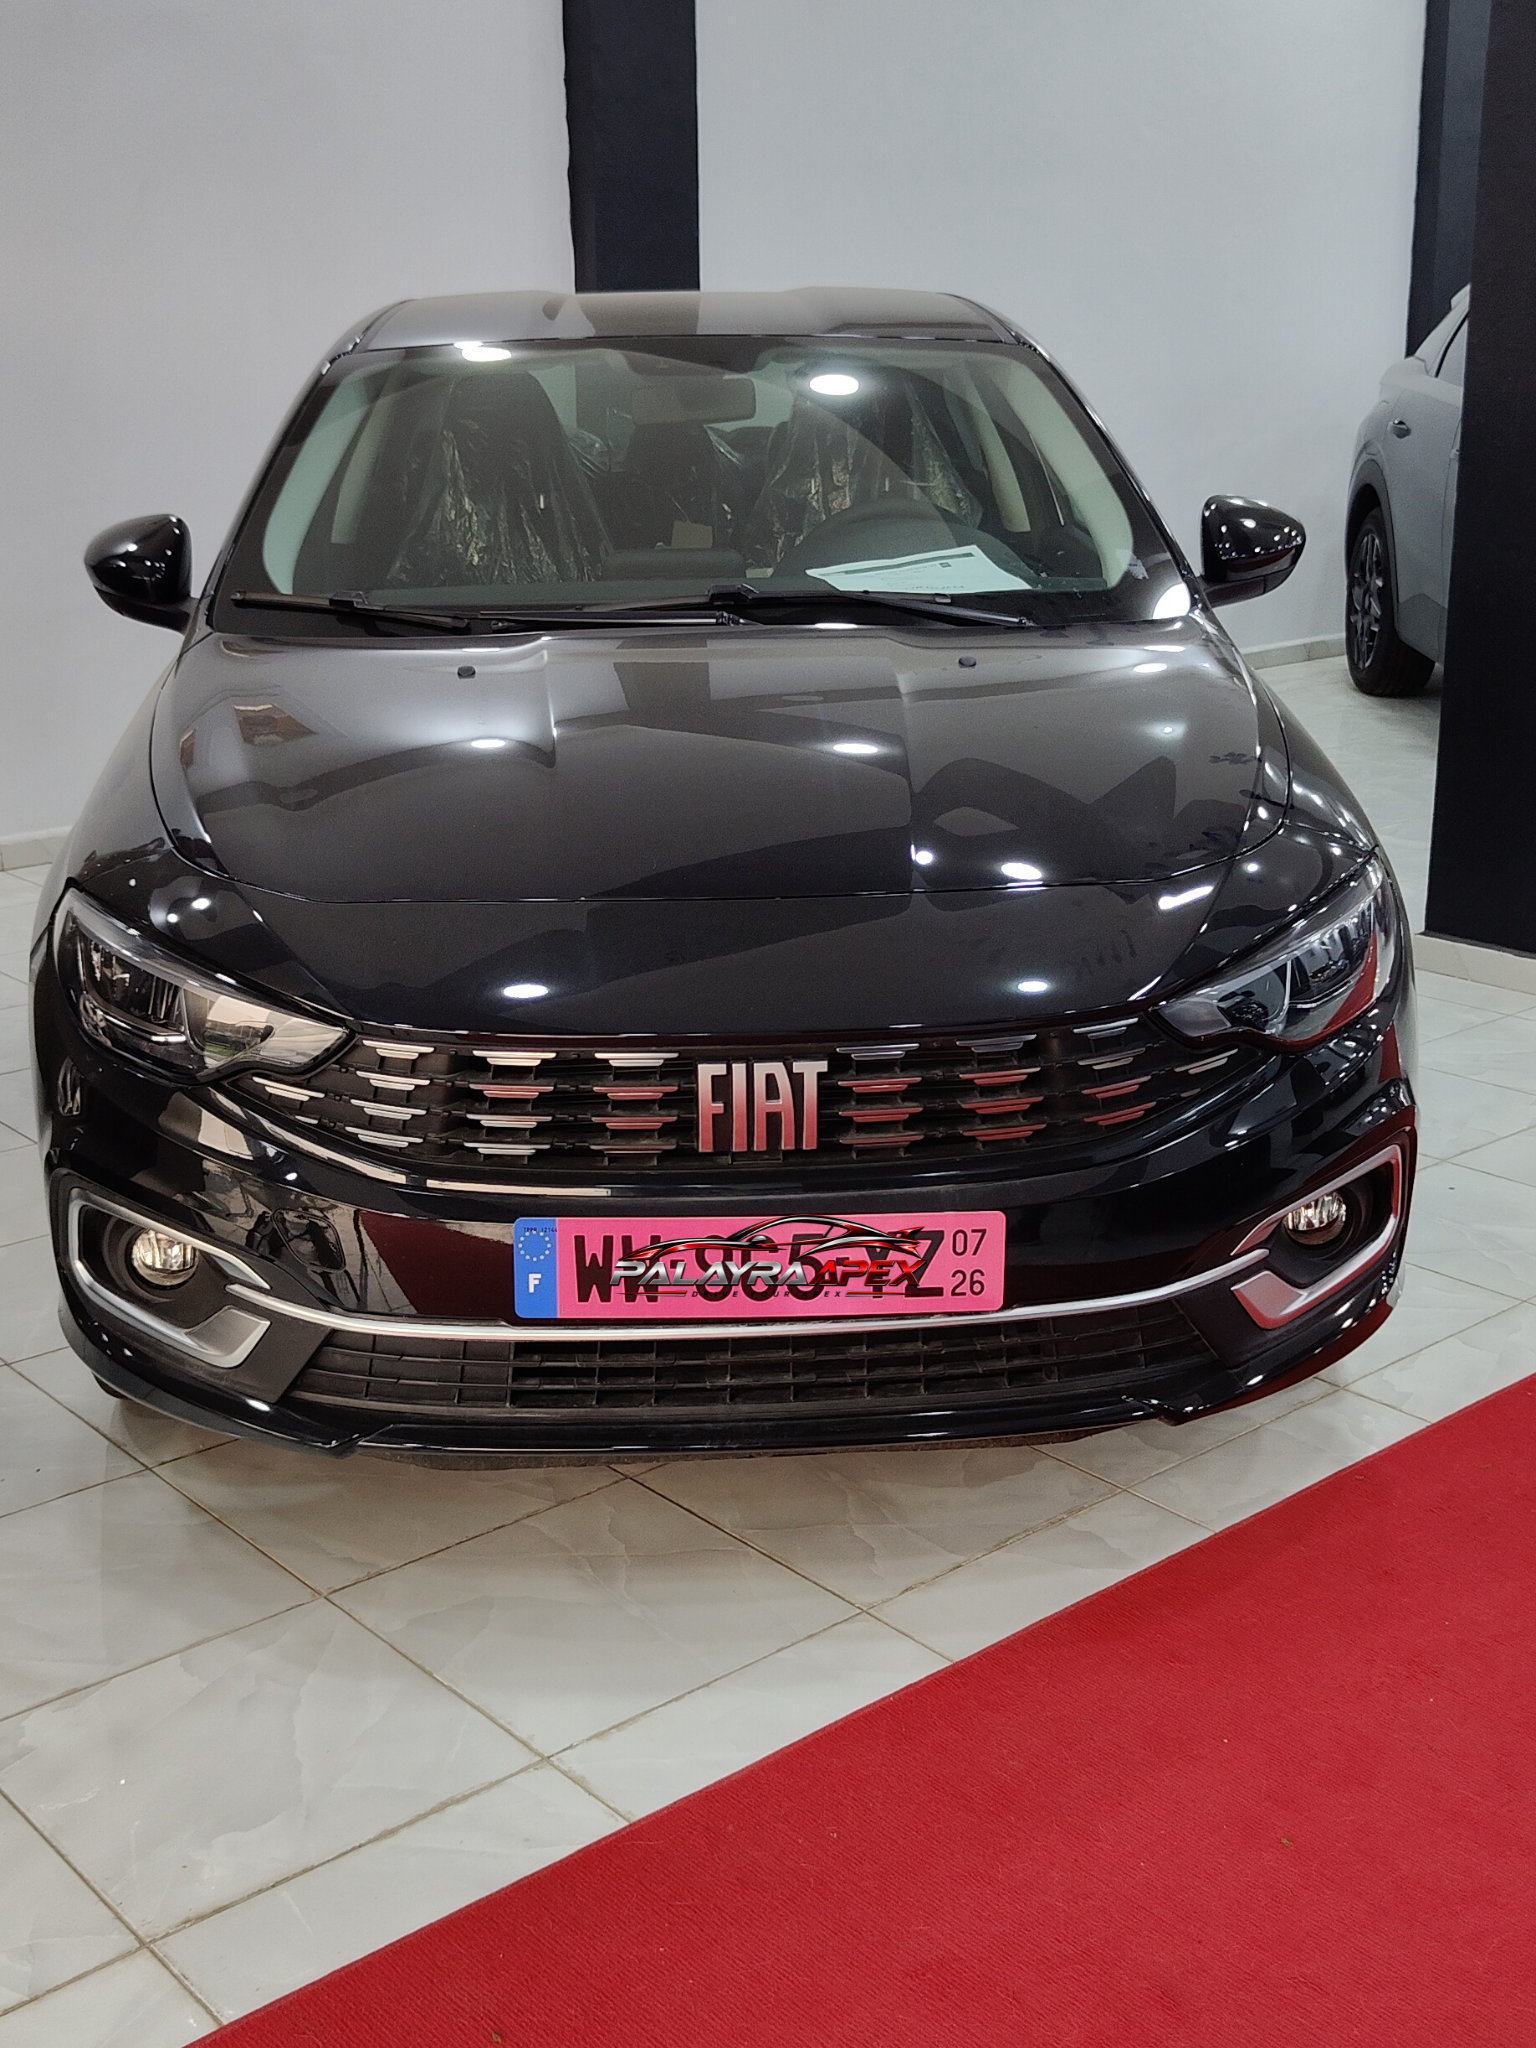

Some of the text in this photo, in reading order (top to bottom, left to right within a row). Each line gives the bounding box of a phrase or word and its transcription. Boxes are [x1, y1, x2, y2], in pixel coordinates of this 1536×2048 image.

[697, 1060, 829, 1153] FIAT
[952, 1229, 987, 1256] 07
[528, 1273, 542, 1293] F
[950, 1269, 986, 1297] 26
